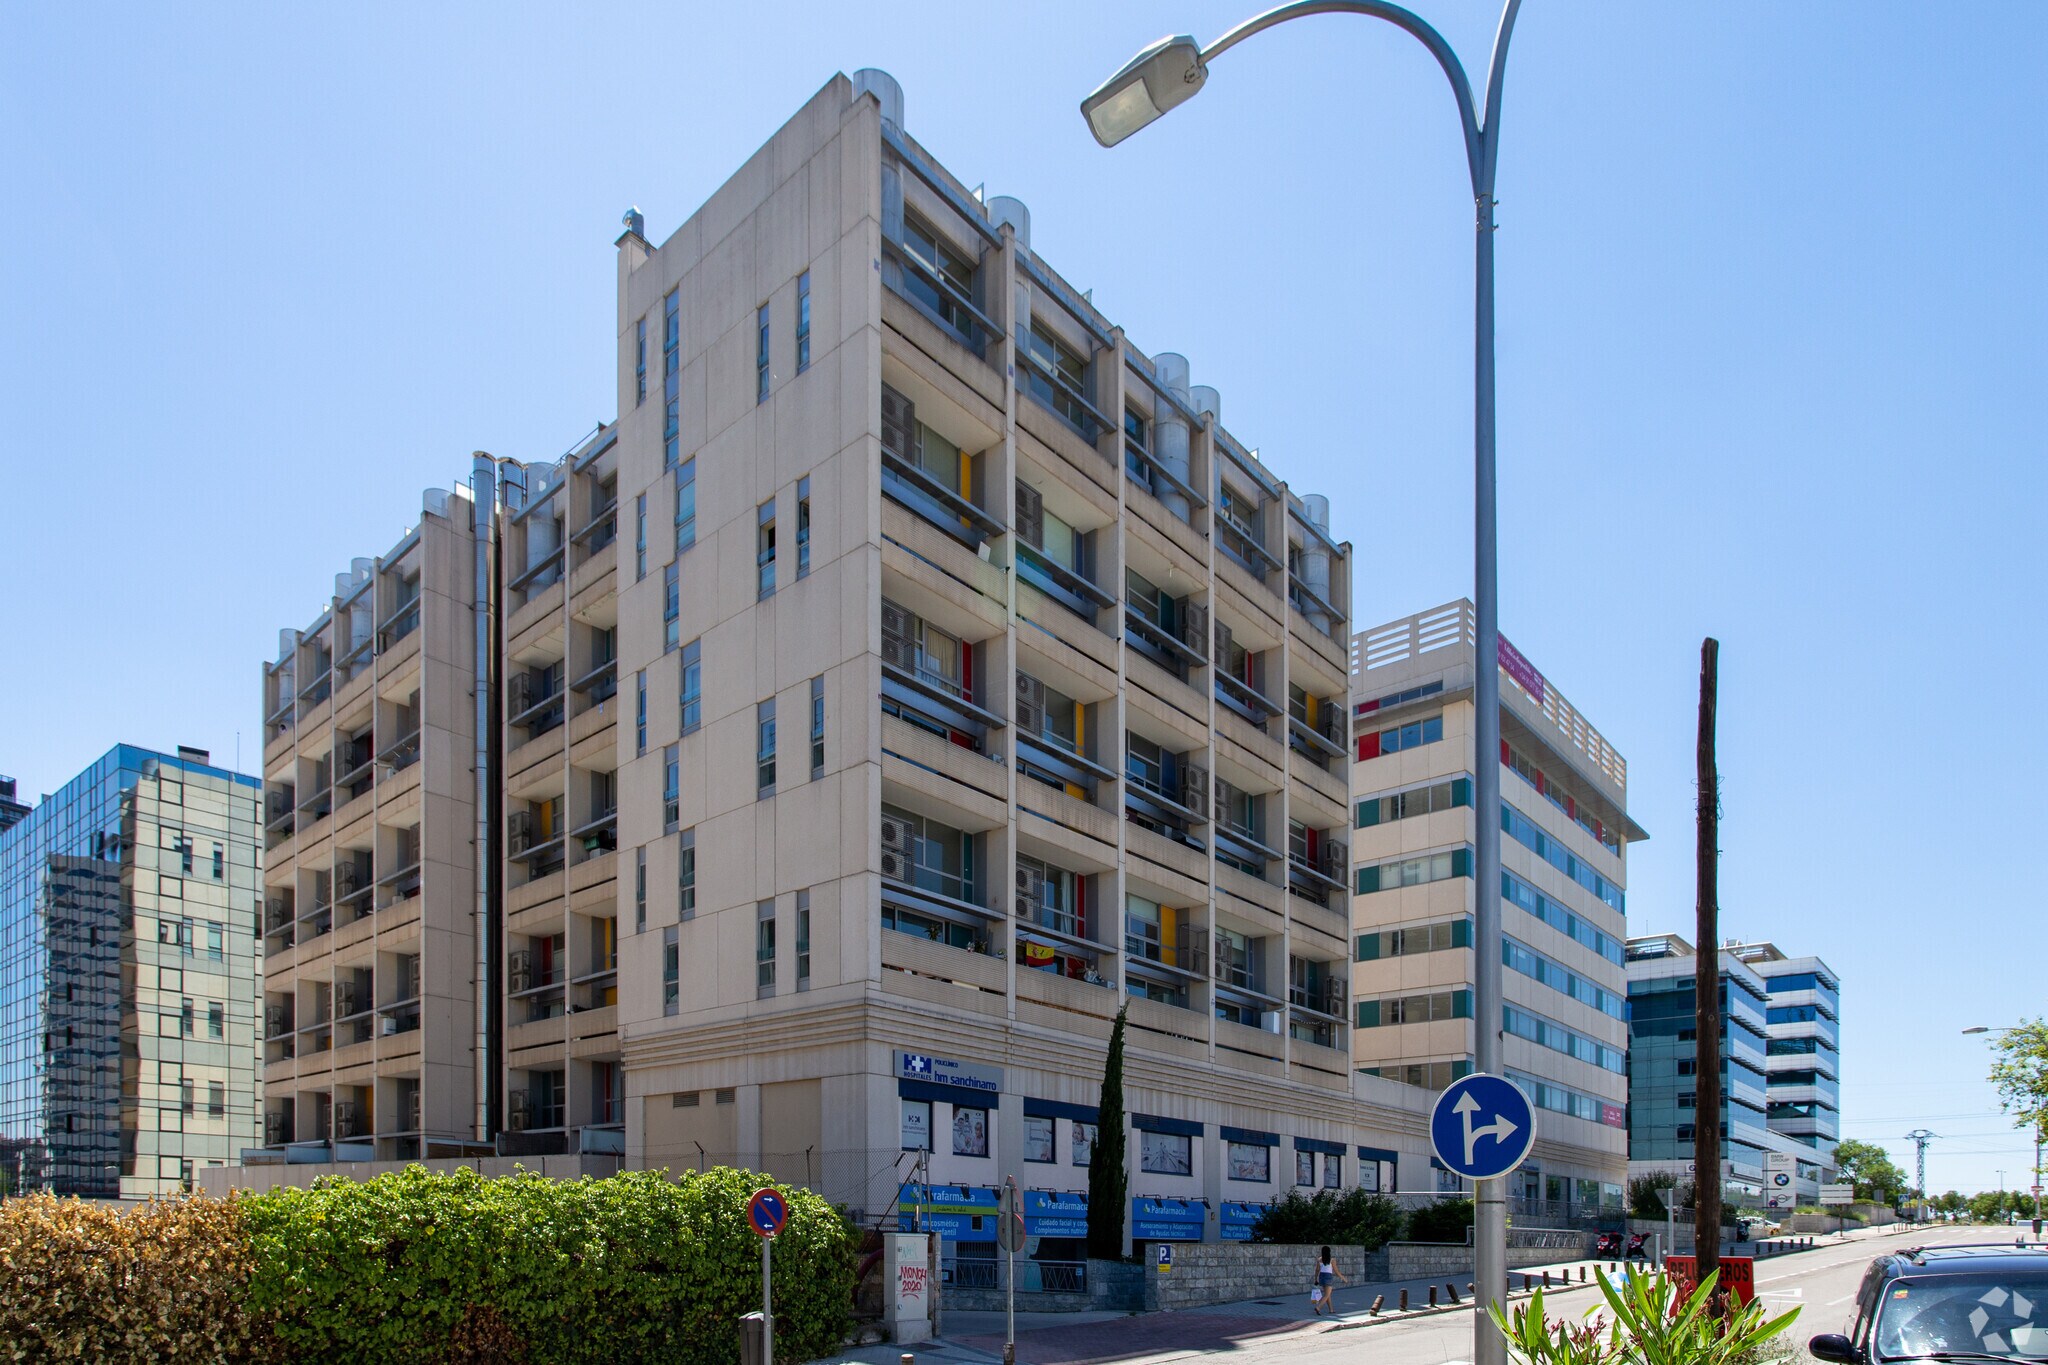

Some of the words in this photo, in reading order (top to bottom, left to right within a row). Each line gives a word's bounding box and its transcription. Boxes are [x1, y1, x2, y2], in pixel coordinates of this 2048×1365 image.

[904, 1071, 931, 1080] HOSPITALES
[935, 1071, 948, 1083] hm
[950, 1075, 997, 1091] sanchinarro
[923, 1190, 976, 1203] rafarmaa
[1151, 1205, 1186, 1216] Parafarmacia
[1077, 1221, 1088, 1229] corp
[1034, 1226, 1070, 1236] Complementos
[1159, 1246, 1167, 1262] P
[902, 1280, 922, 1292] 2020
